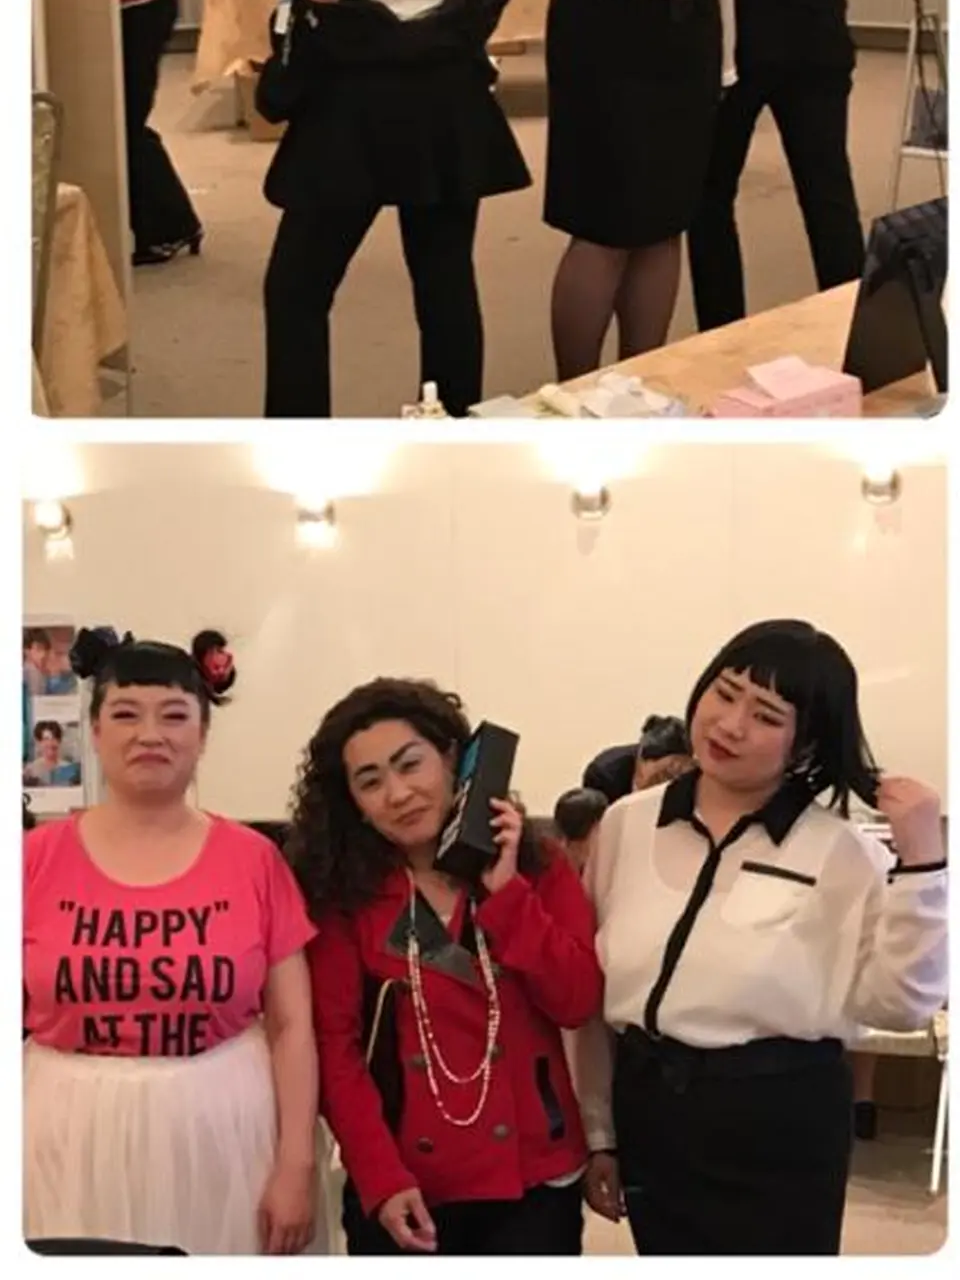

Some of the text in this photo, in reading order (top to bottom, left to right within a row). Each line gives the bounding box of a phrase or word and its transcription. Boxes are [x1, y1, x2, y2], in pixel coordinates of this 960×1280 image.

[59, 900, 230, 948] "HAPPY"
[54, 954, 235, 1005] AND SAD
[133, 1012, 211, 1056] THE
